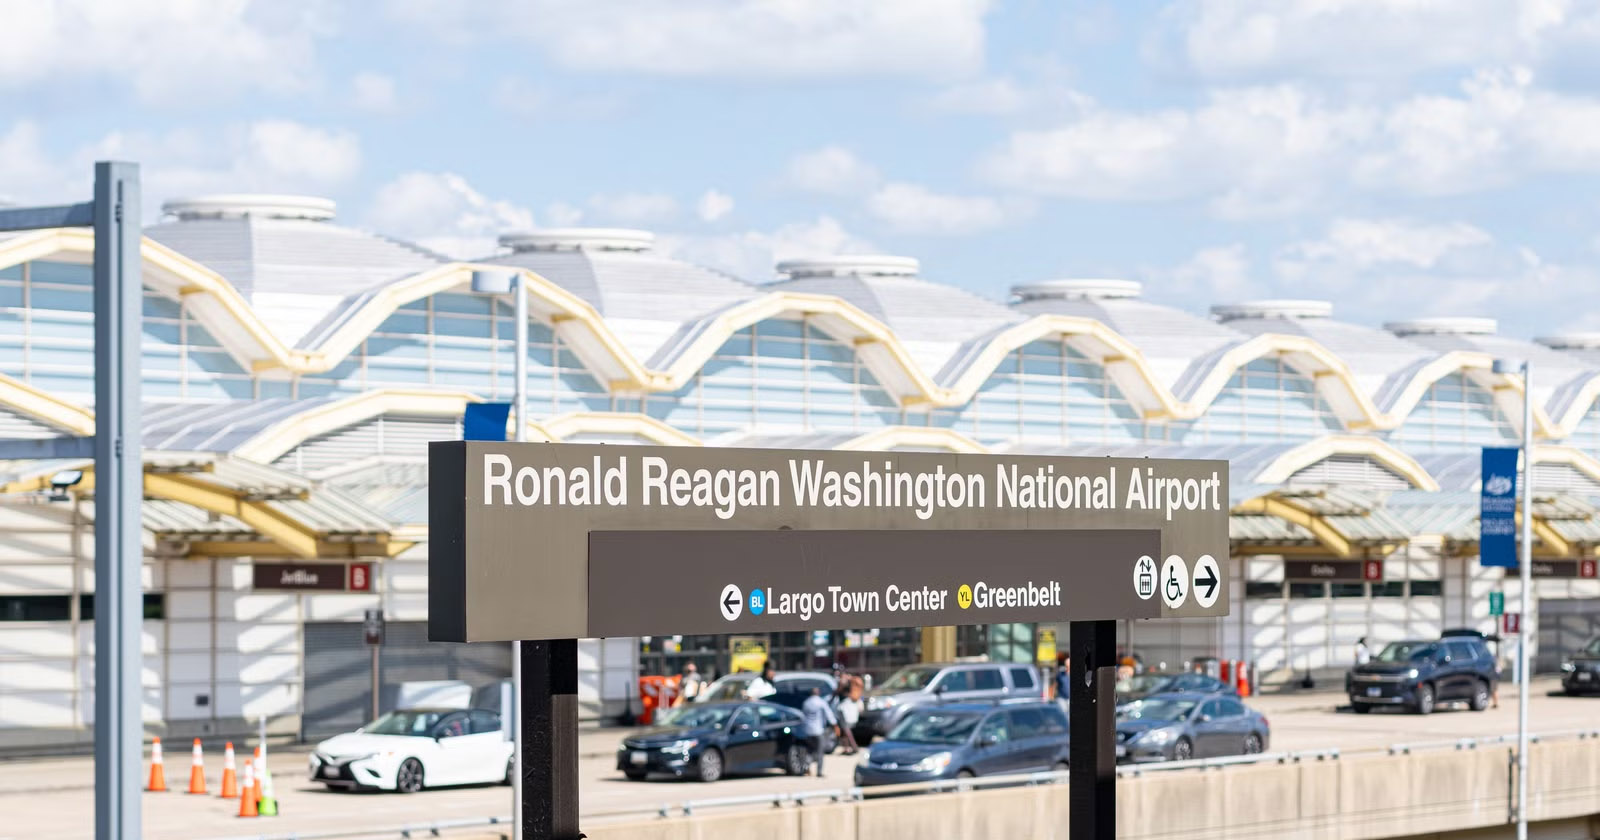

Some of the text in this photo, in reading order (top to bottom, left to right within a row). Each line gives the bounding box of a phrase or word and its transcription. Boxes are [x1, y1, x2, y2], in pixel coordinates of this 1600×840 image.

[483, 453, 1222, 521] Ronald Reagan Washington National Airport
[280, 569, 319, 585] JetBlue
[352, 567, 366, 589] B
[751, 580, 1061, 621] BL Largo Town Center YL Greenbelt
